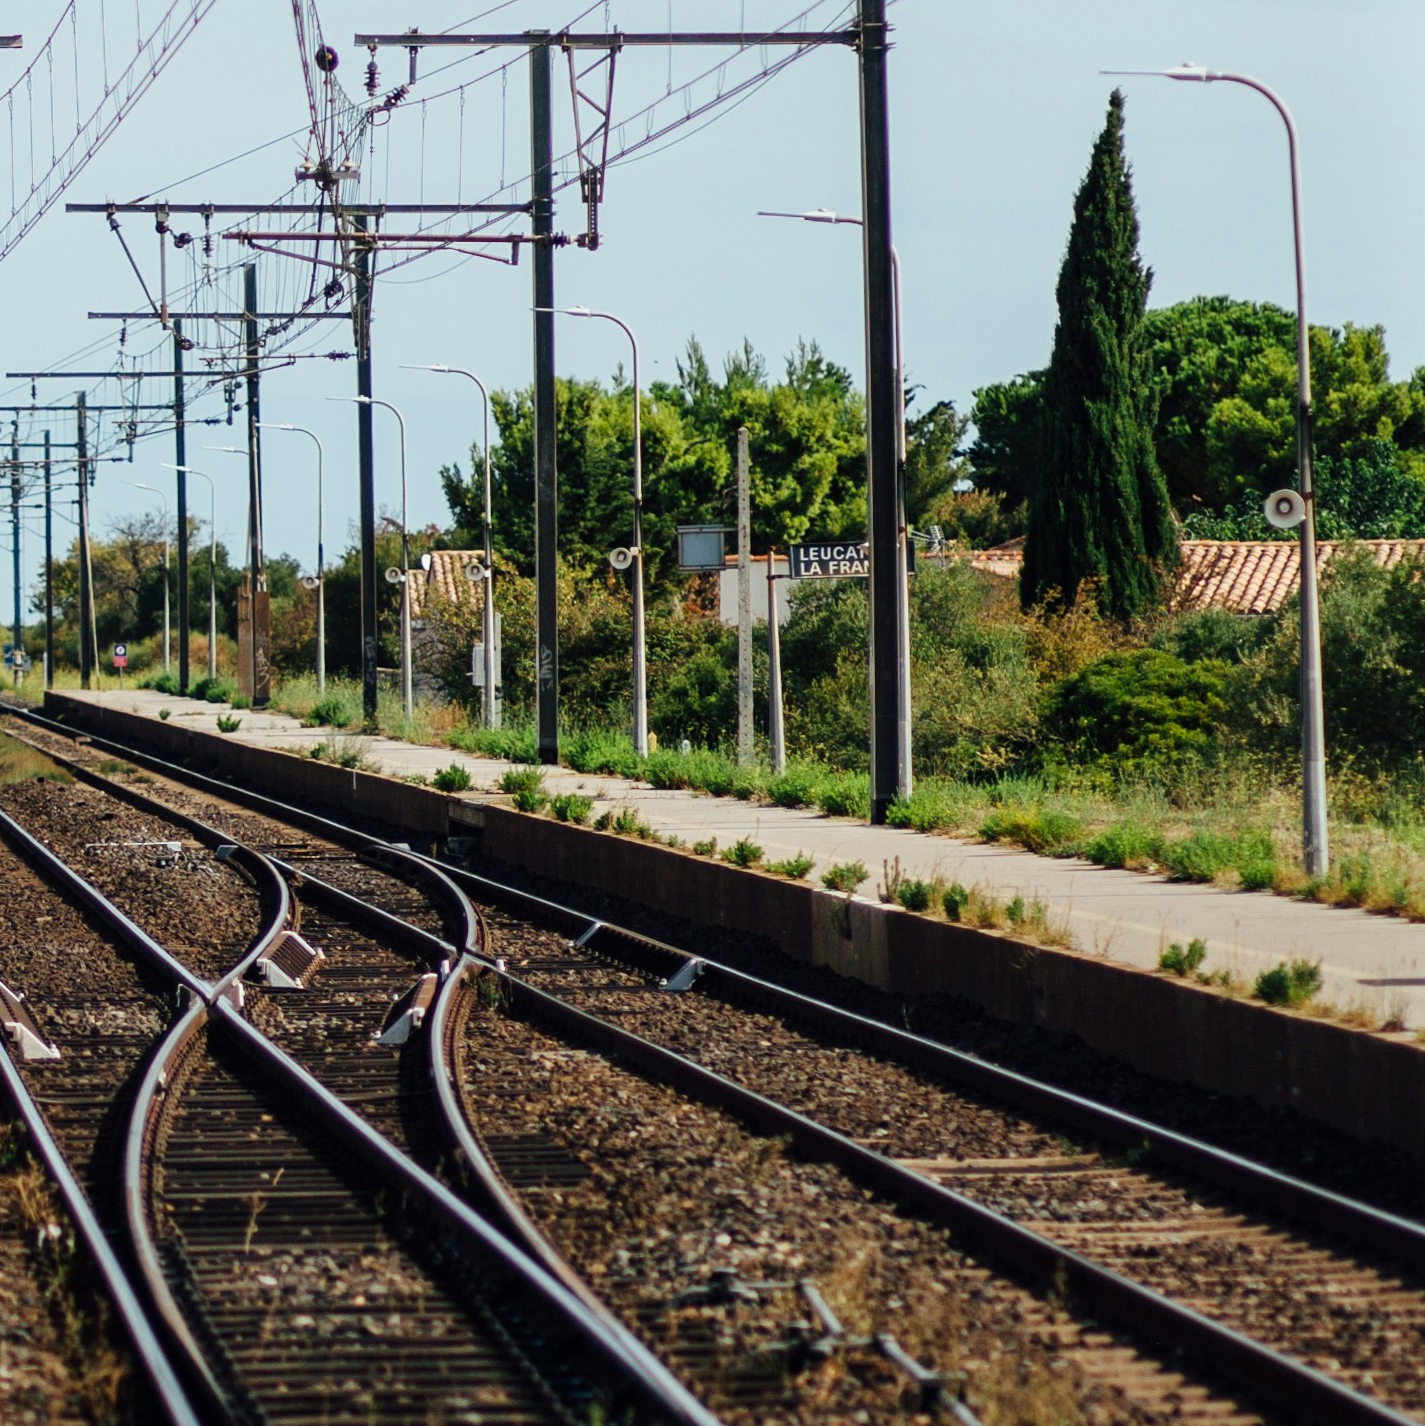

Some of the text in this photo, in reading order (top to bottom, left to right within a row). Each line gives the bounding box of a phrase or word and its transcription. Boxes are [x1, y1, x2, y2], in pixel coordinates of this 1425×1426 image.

[799, 545, 868, 561] LEUCAT
[800, 560, 870, 575] LA FRAN
